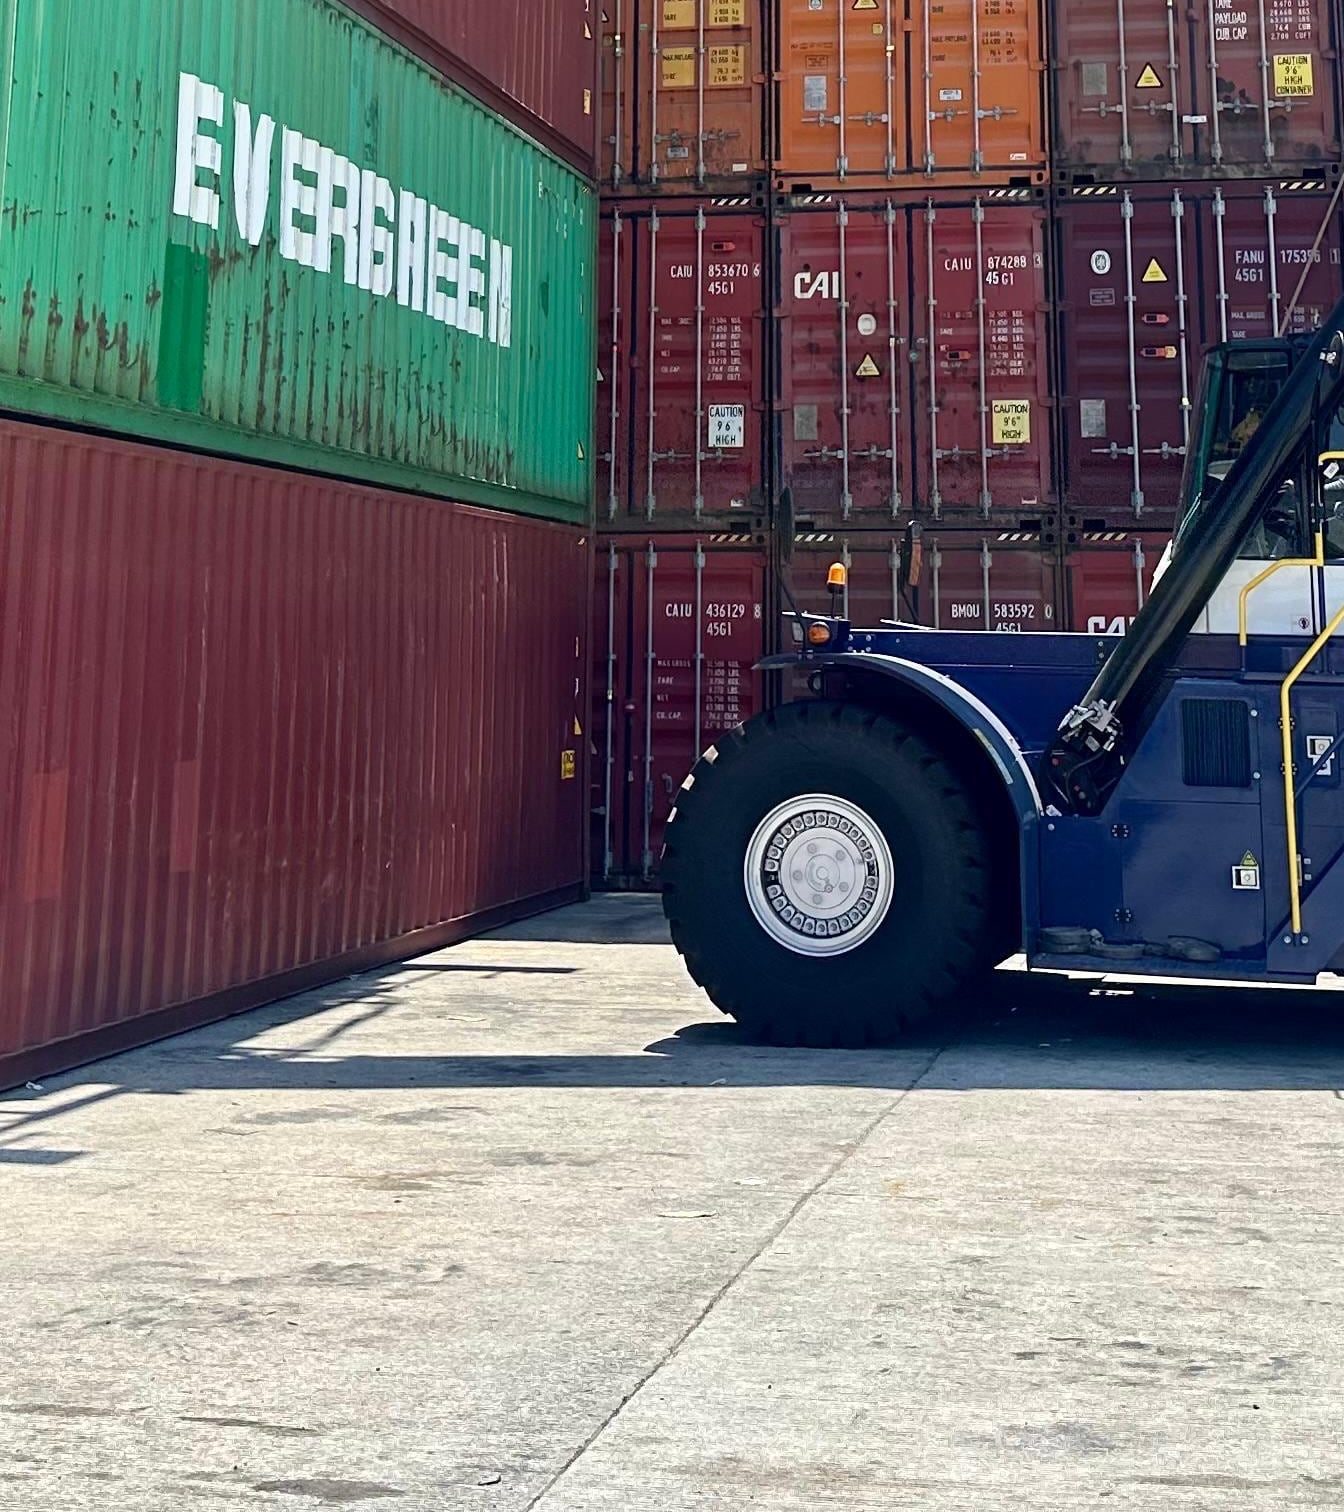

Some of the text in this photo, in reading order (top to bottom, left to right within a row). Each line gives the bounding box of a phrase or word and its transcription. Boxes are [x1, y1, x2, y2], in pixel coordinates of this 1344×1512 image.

[173, 70, 514, 349] EVERGREEN
[945, 255, 1027, 271] CAIU 874288
[1236, 250, 1264, 264] FANU
[671, 265, 693, 278] CAIU
[708, 263, 748, 277] 853670
[1236, 268, 1264, 282] 45G1
[708, 282, 735, 295] 45G1
[794, 271, 840, 299] CAI
[709, 405, 743, 419] CAUTION
[715, 433, 736, 445] HIGH
[665, 603, 692, 618] CAIU
[705, 602, 746, 618] 436129
[951, 603, 1035, 619] BMOU 583592
[706, 620, 733, 636] 45G1
